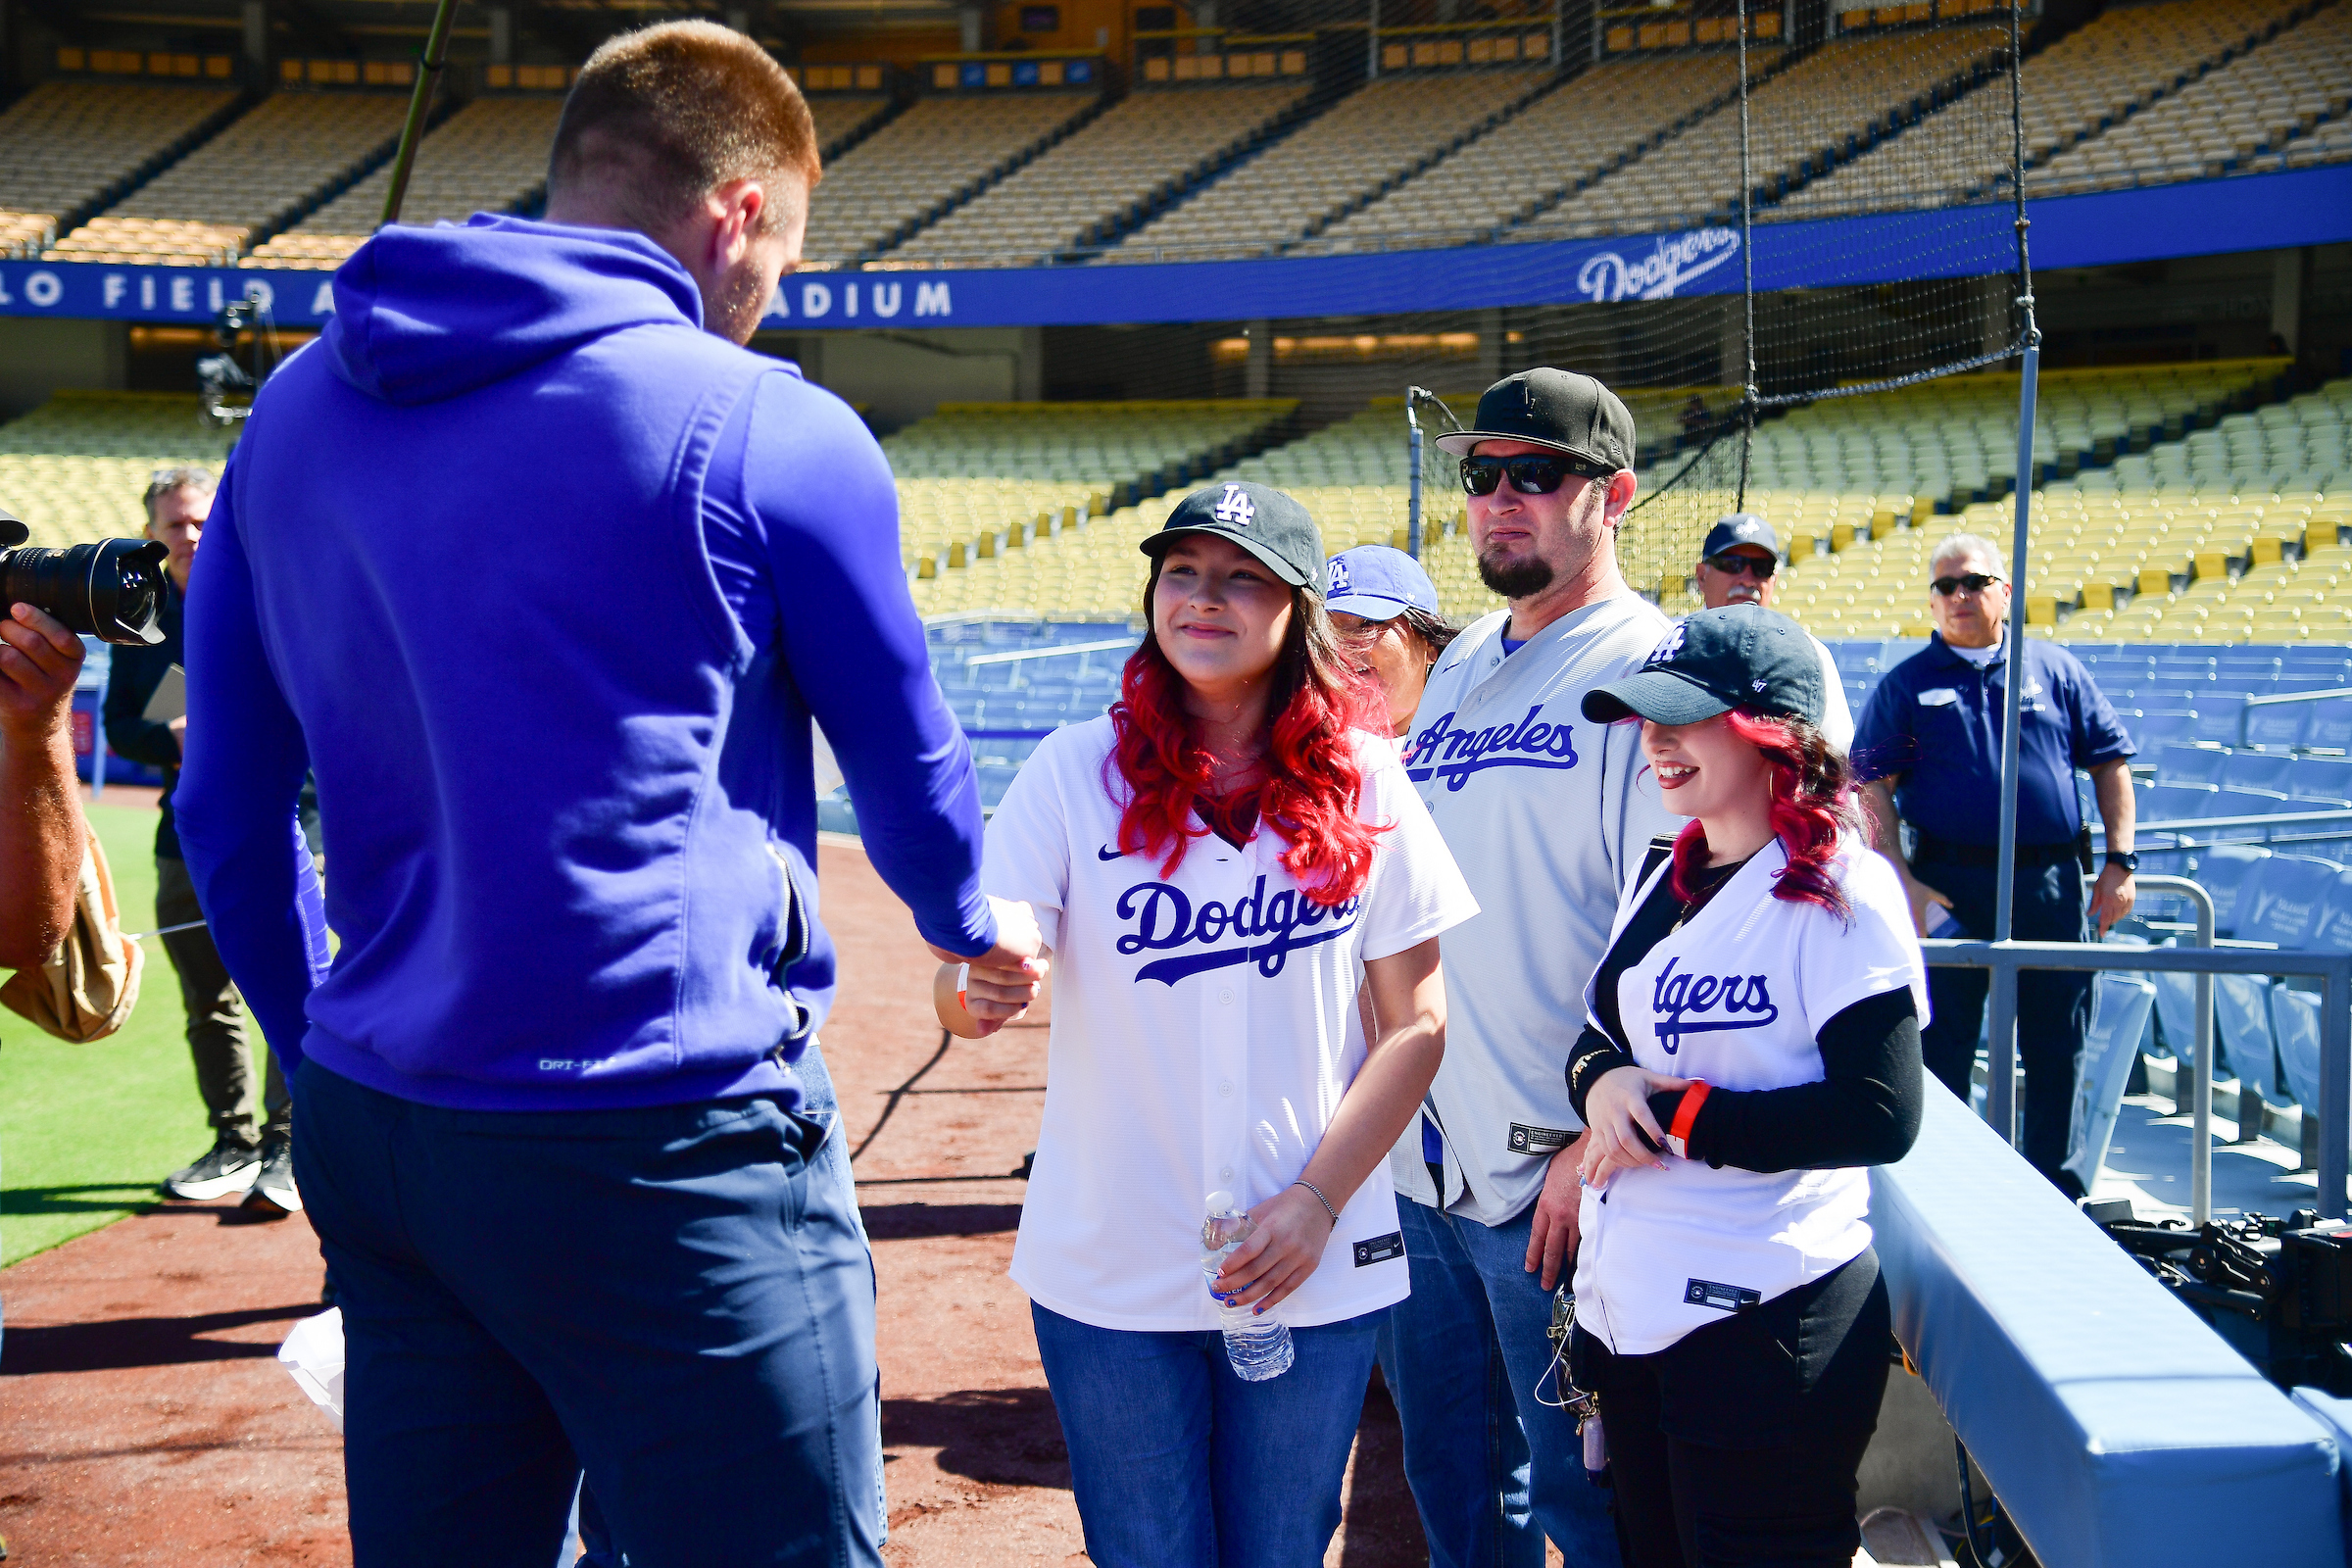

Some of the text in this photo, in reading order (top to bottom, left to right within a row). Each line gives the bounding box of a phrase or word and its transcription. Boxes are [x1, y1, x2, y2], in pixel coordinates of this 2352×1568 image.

[102, 272, 273, 314] FIELD
[1577, 226, 1740, 303] Dodgers
[1216, 484, 1255, 526] LA
[1405, 704, 1579, 792] Angeles
